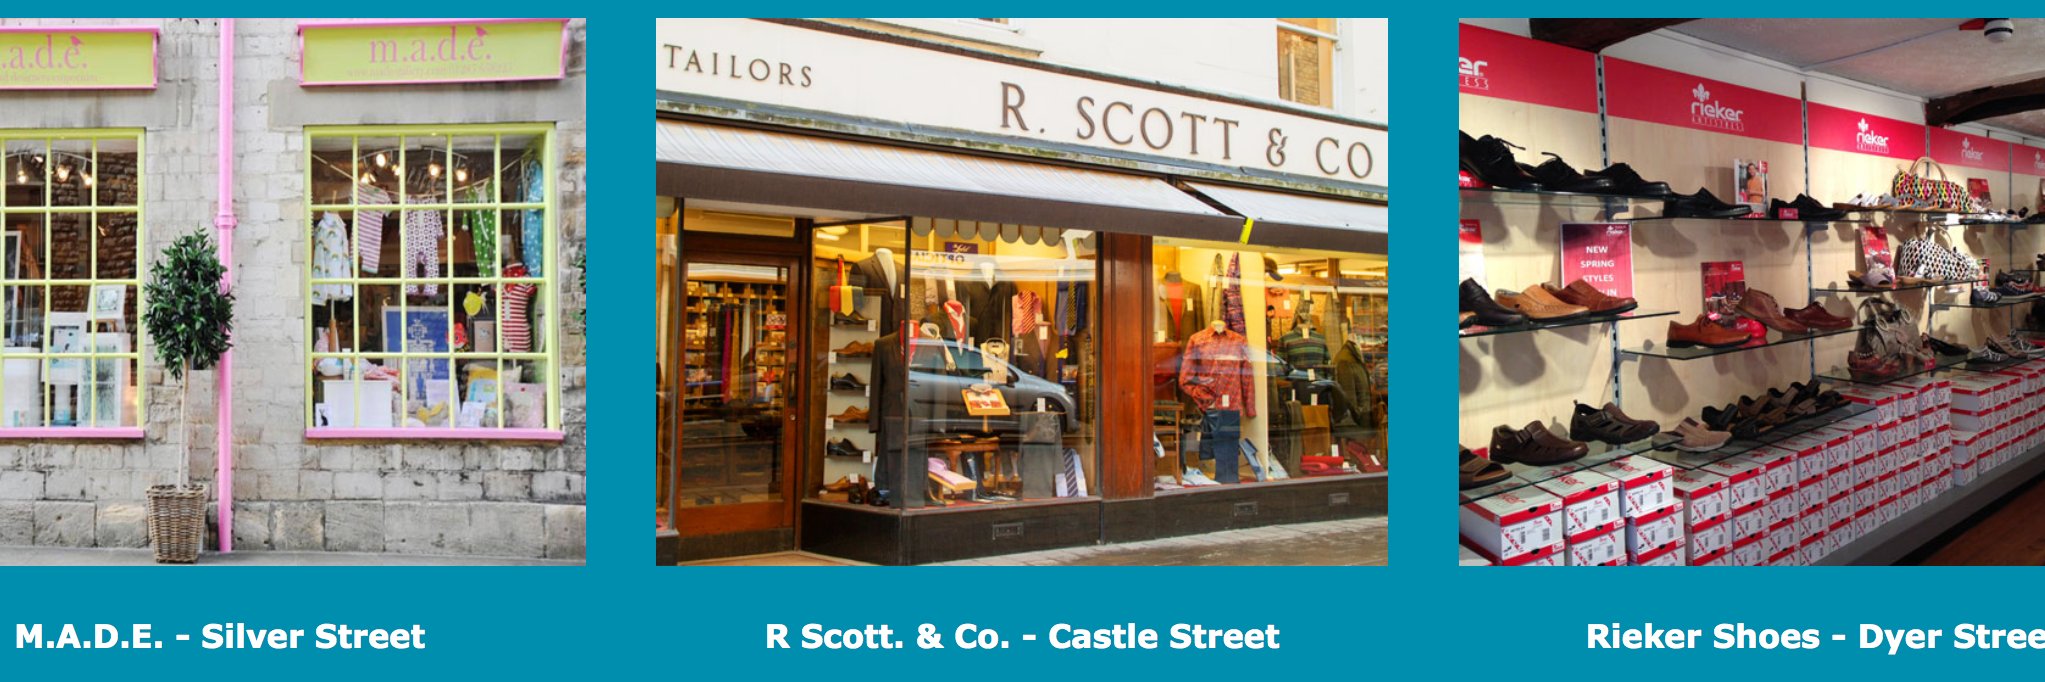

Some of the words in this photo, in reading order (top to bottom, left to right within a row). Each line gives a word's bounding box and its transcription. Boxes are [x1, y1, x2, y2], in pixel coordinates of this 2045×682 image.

[663, 44, 812, 88] TAILORS
[1691, 100, 1744, 122] rieker
[1000, 81, 1045, 133] R.
[1076, 96, 1239, 160] SCOTT
[1266, 127, 1288, 168] &
[1315, 137, 1373, 179] CO
[1586, 246, 1608, 254] NEW
[1580, 260, 1615, 269] SPRING
[1583, 274, 1614, 283] STYLES
